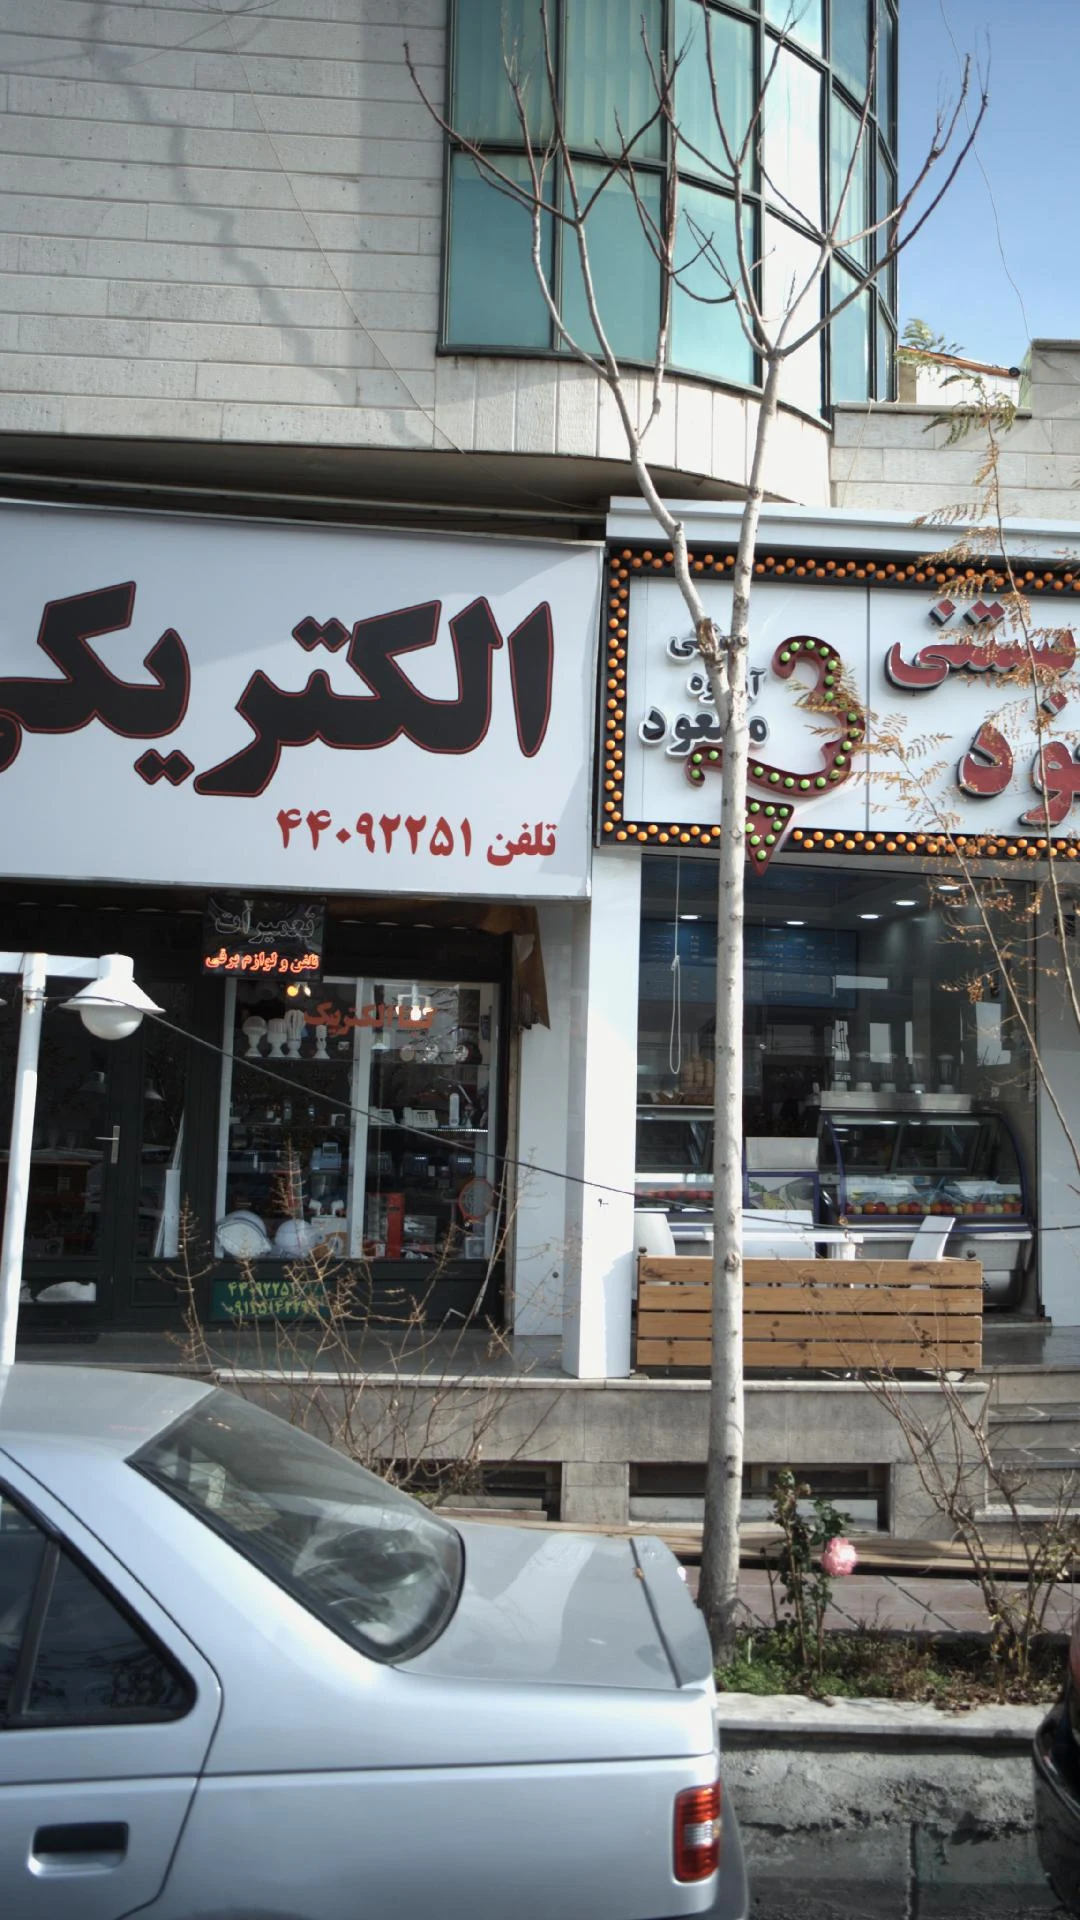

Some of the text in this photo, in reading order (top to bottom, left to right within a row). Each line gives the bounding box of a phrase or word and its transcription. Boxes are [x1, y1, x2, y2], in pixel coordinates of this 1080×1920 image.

[0, 580, 555, 798] الکتریک
[640, 706, 769, 756] معود
[276, 808, 558, 867] تلفن ۴۴۰۹۲۲۵۱
[214, 910, 316, 944] تعمیرات
[205, 947, 320, 973] تلفن و لوازم برقی
